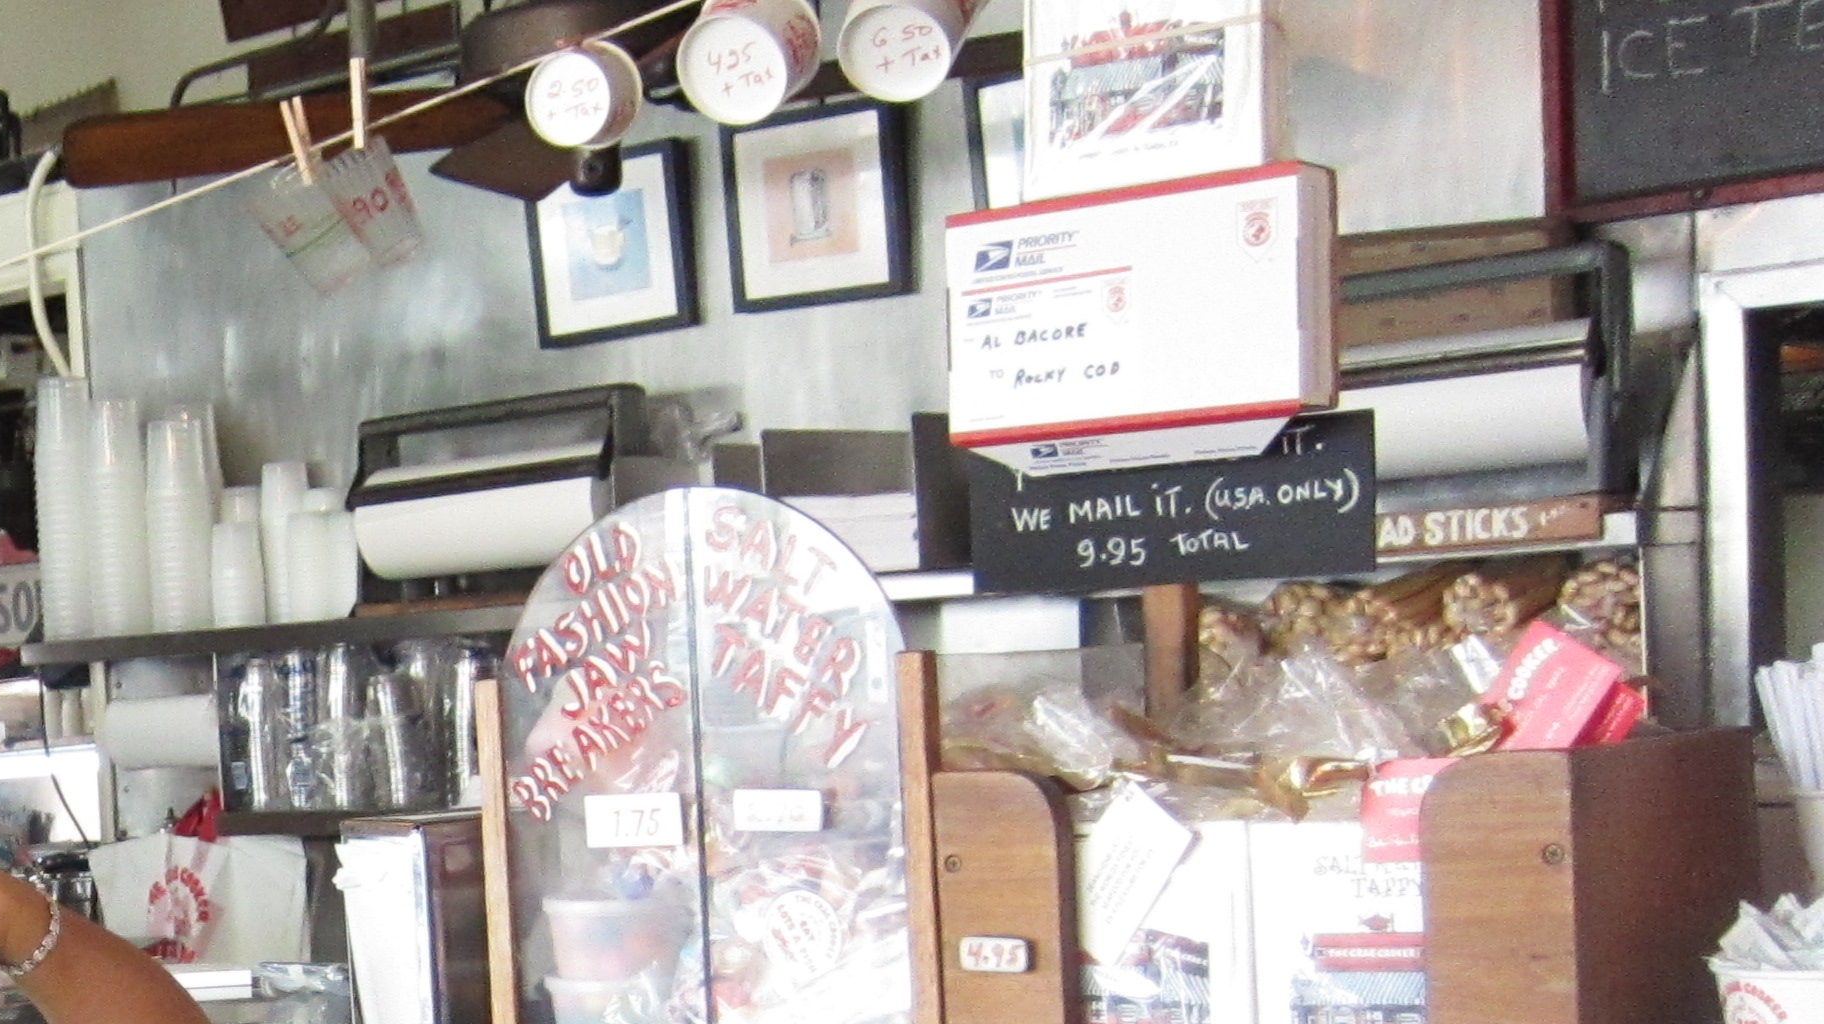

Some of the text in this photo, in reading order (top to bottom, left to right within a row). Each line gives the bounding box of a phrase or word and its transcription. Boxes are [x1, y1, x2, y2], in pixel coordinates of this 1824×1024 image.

[1600, 16, 1710, 95] ICE
[1015, 252, 1046, 267] MAIL
[1017, 231, 1076, 249] PRIORITY
[1014, 323, 1088, 345] BACORE
[1083, 361, 1120, 379] COD
[1011, 506, 1052, 533] WE
[1068, 494, 1142, 525] MAIL
[1277, 467, 1361, 515] ONLY)
[1423, 507, 1530, 546] STICKS
[562, 521, 642, 595] OLD
[705, 506, 837, 596] SALT
[1076, 536, 1147, 568] 9.95
[513, 556, 677, 693] FASHION
[703, 566, 862, 700] WATER
[561, 613, 652, 721] JAW
[712, 624, 868, 769] TAFFY
[512, 659, 688, 822] BREAKERS
[612, 806, 661, 837] 1.75
[964, 943, 1027, 969] 4.95
